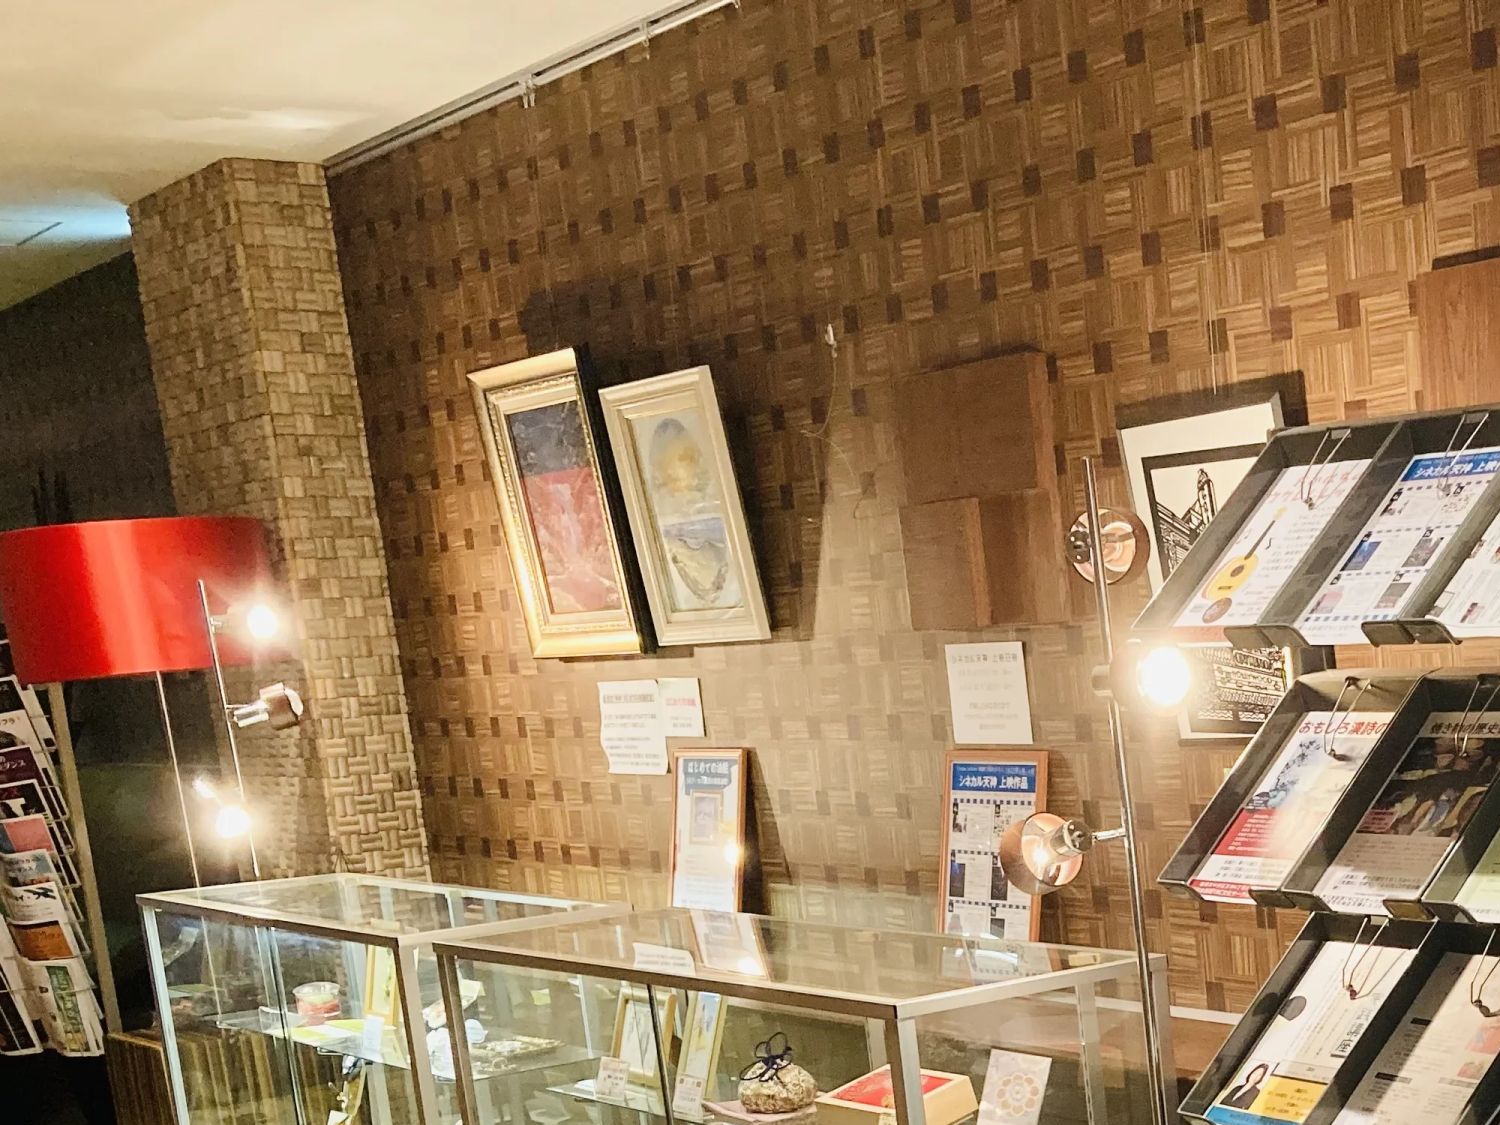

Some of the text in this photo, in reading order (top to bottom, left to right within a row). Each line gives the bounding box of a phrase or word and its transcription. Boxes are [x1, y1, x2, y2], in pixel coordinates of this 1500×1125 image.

[959, 775, 1029, 790] シネカル天神 上映作品
